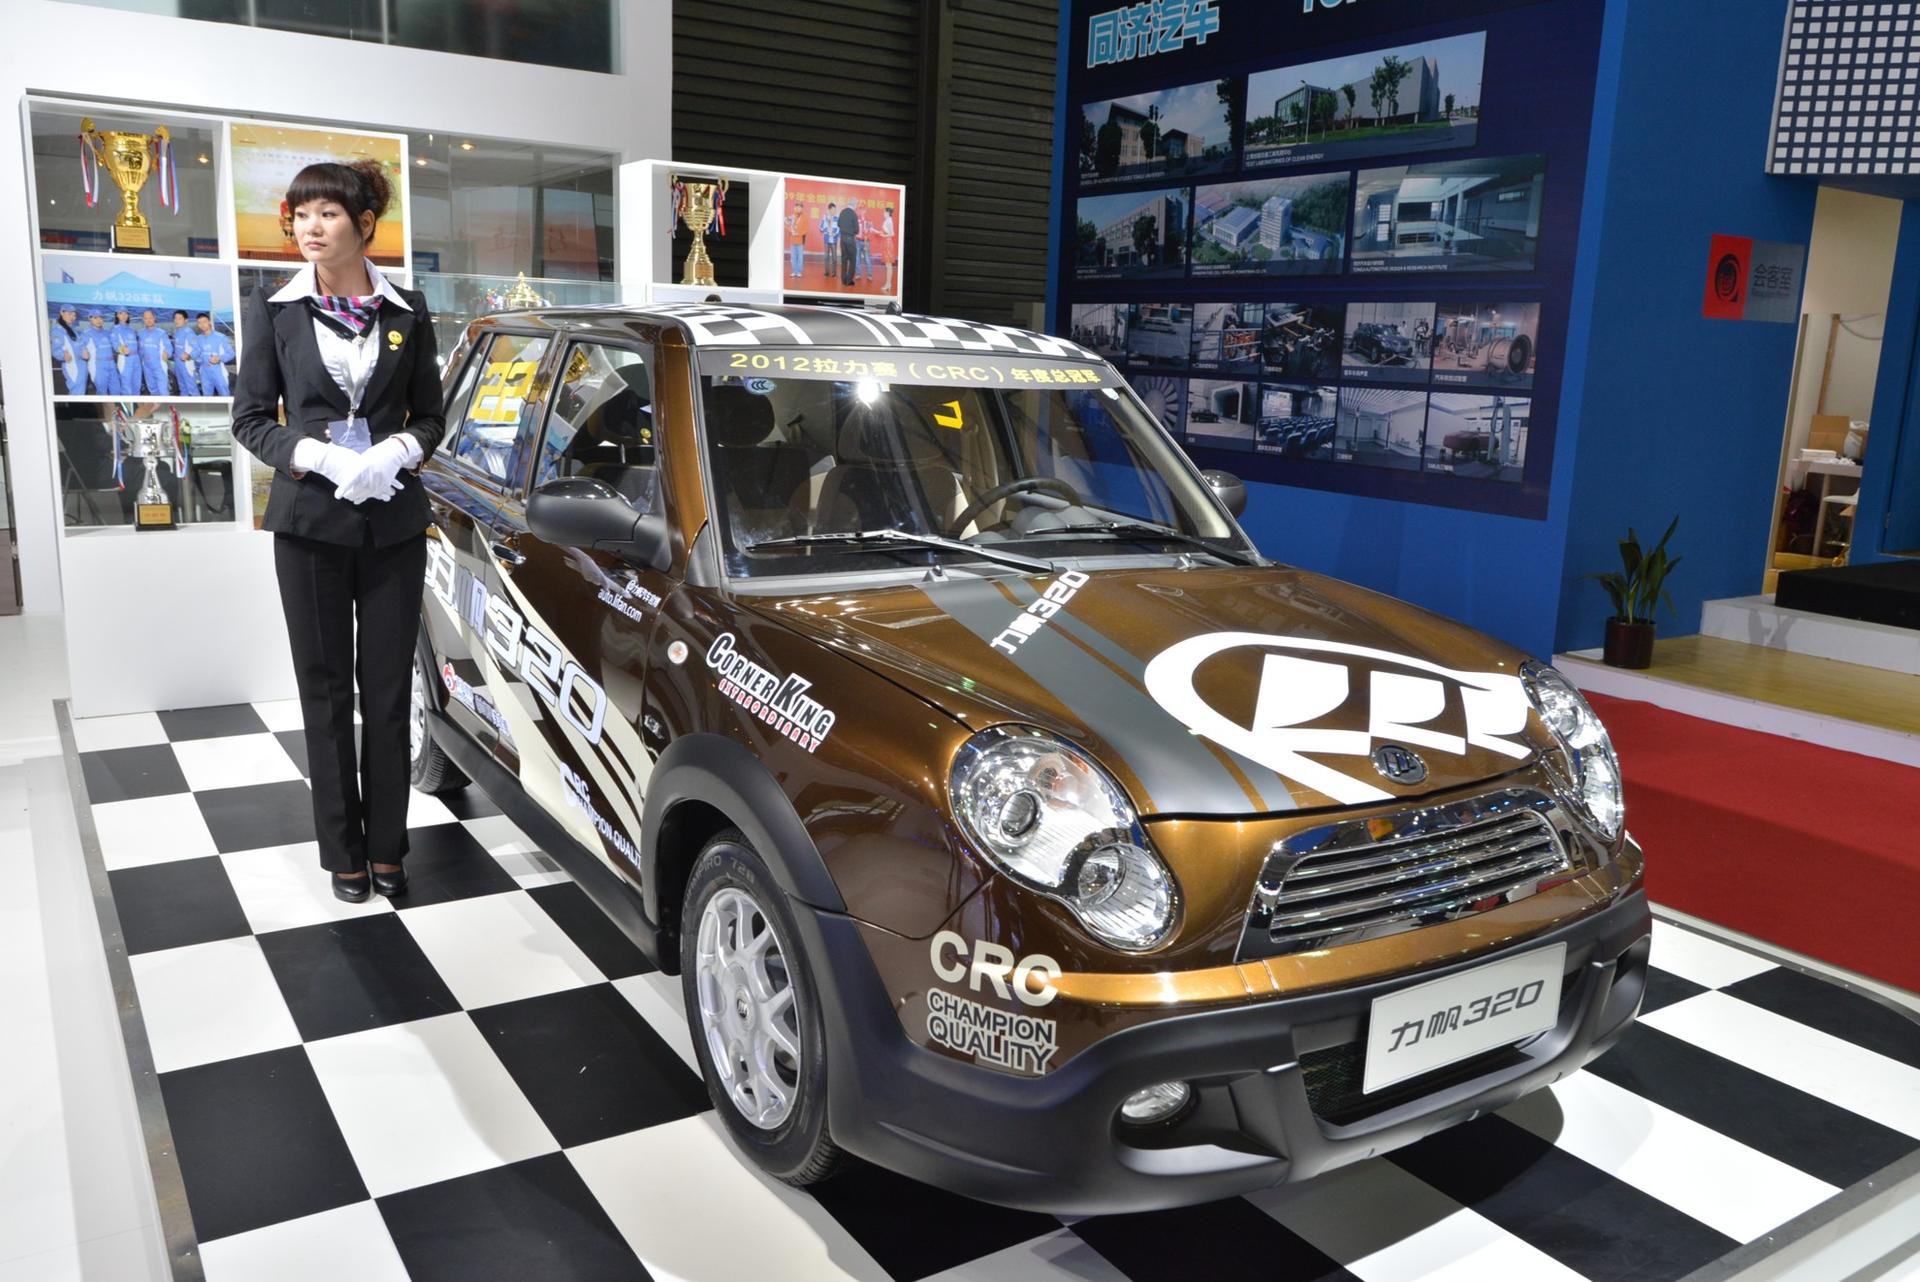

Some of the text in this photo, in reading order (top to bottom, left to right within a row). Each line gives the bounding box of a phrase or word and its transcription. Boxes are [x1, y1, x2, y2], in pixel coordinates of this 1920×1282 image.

[1087, 0, 1220, 69] 同济汽车
[597, 588, 643, 623] auto.lifan.com
[989, 570, 1091, 655] 力帆320
[705, 632, 836, 741] CORNER KING
[930, 930, 1062, 1007] CRC
[927, 987, 1057, 1049] CHAMPION
[927, 1011, 1059, 1075] QUALITY
[1388, 980, 1545, 1053] 力帆320
